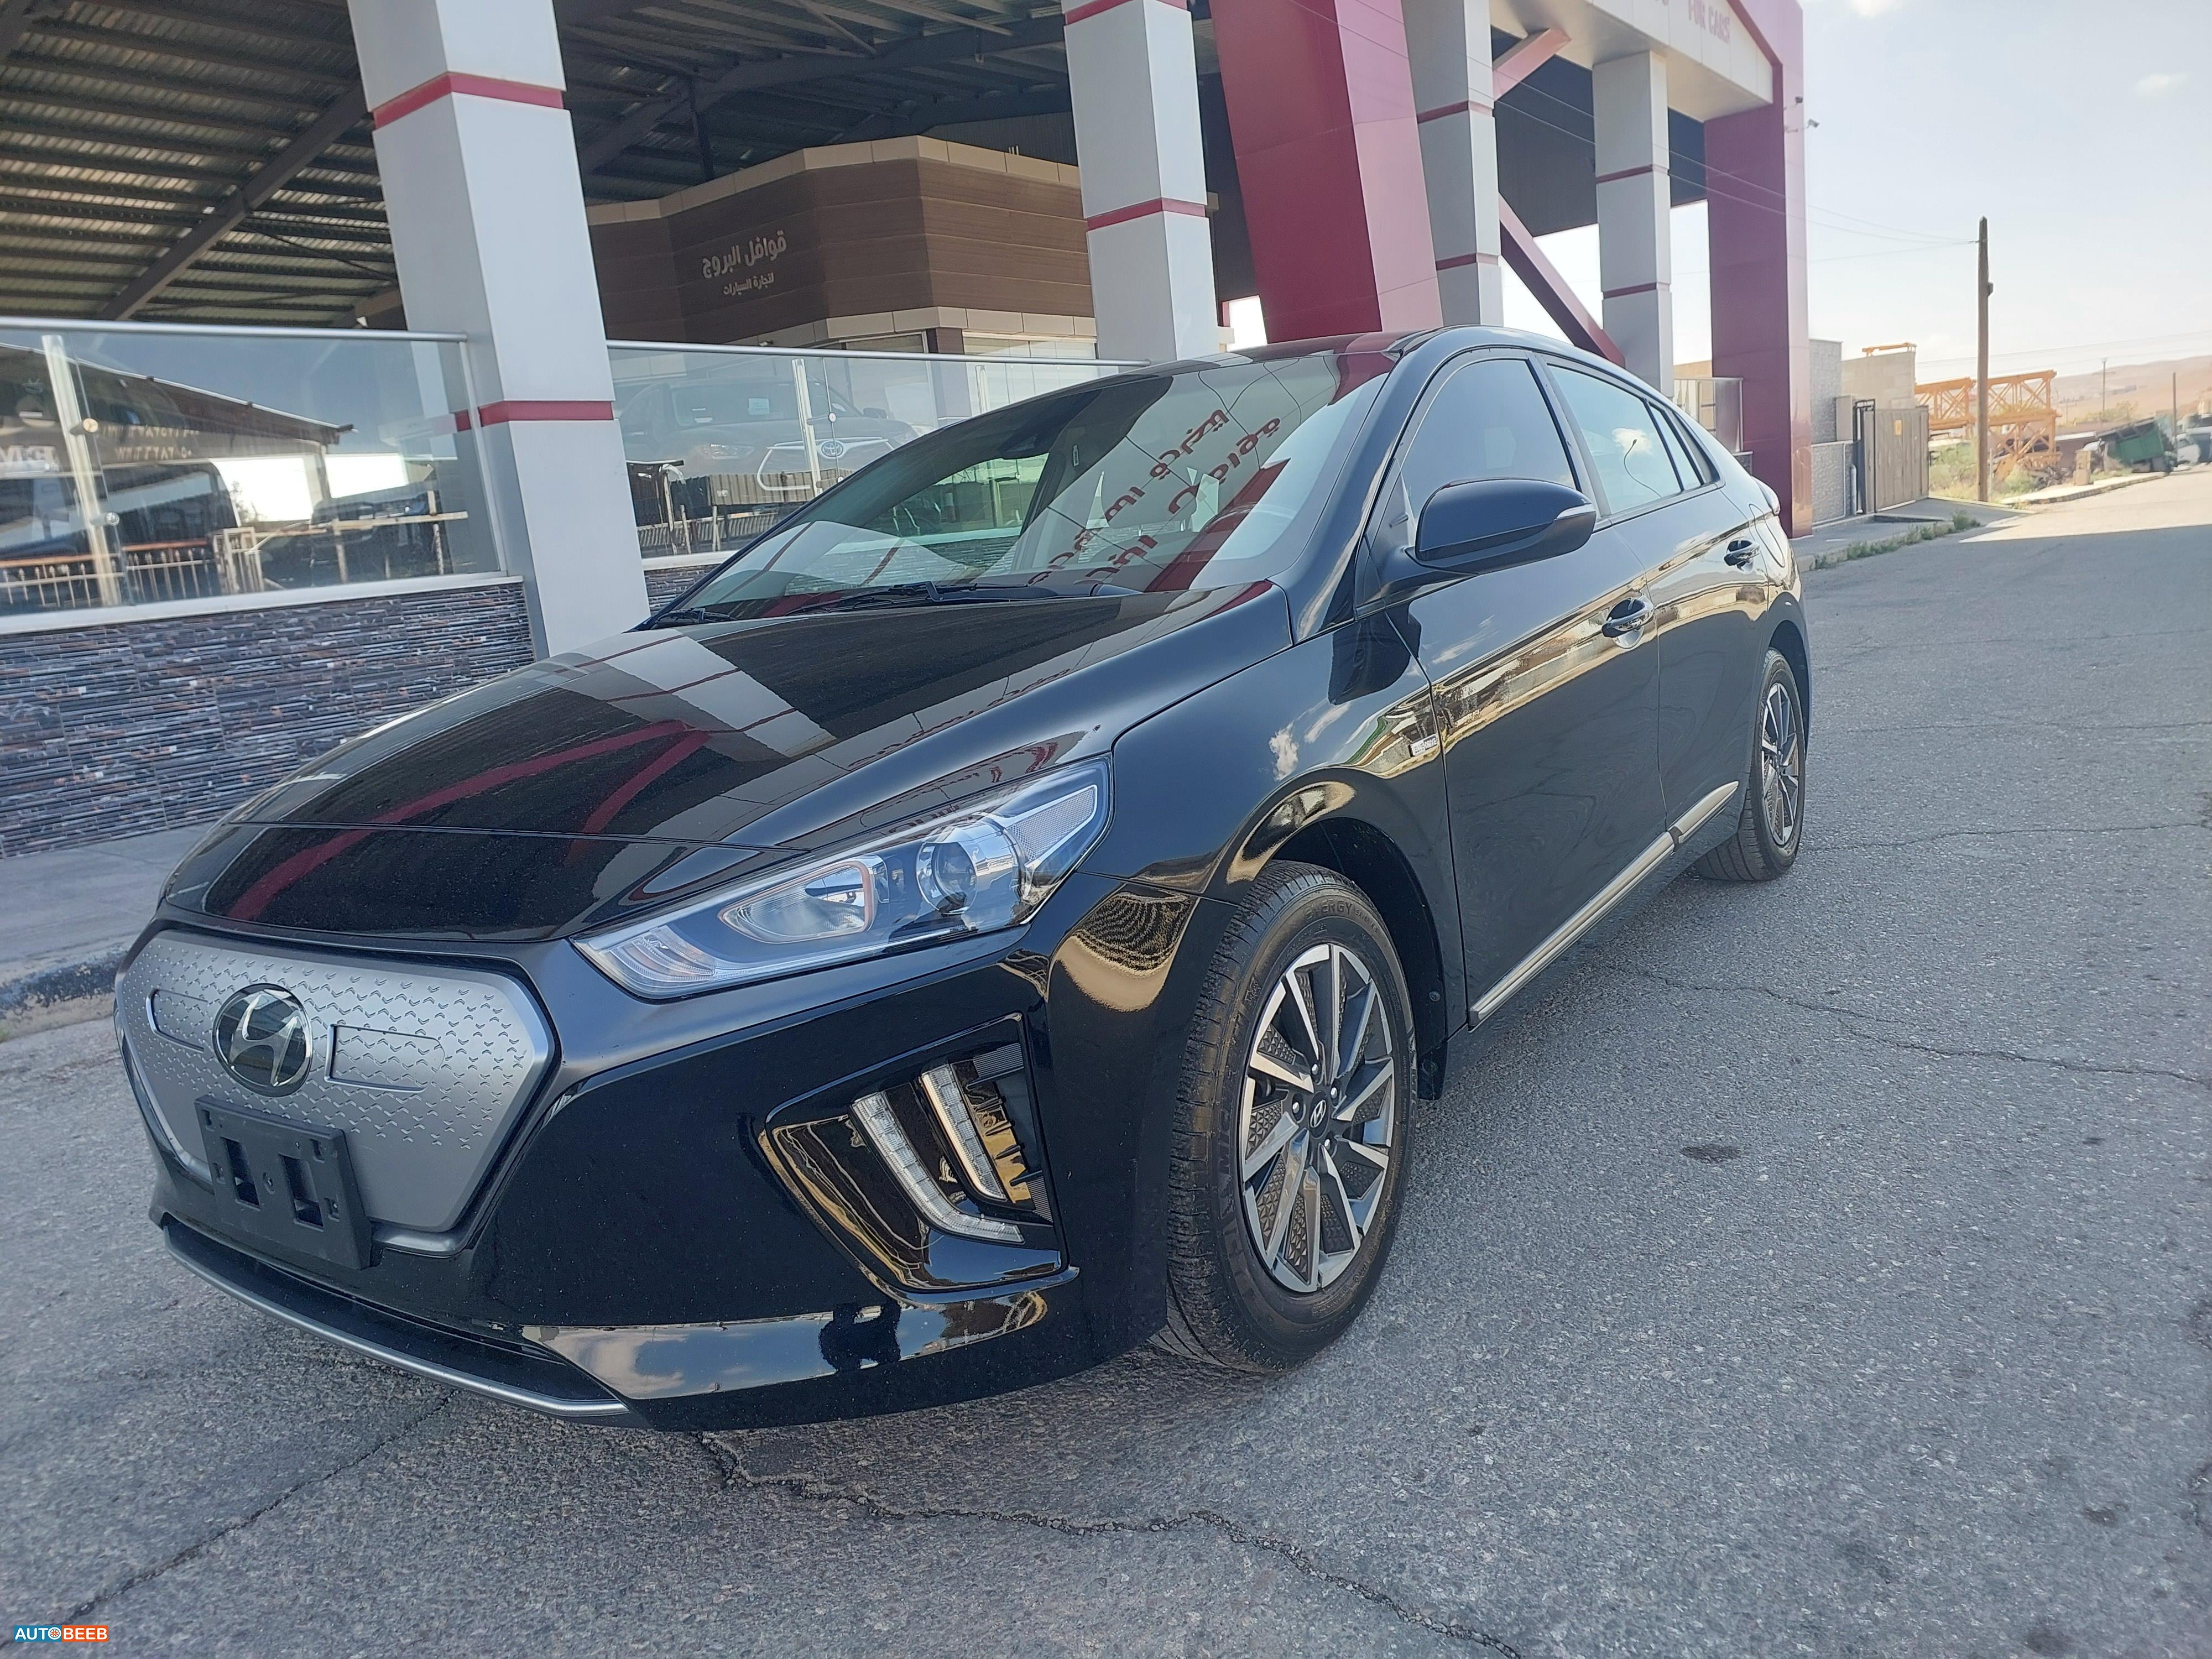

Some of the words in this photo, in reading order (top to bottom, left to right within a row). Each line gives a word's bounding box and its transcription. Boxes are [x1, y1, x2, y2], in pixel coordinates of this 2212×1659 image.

[745, 229, 787, 267] قوافل
[702, 245, 740, 279] البروج
[723, 278, 752, 295] السيارات
[753, 272, 774, 289] لتجارة
[1424, 737, 1437, 749] DRIVE
[1304, 898, 1353, 920] ENERGY
